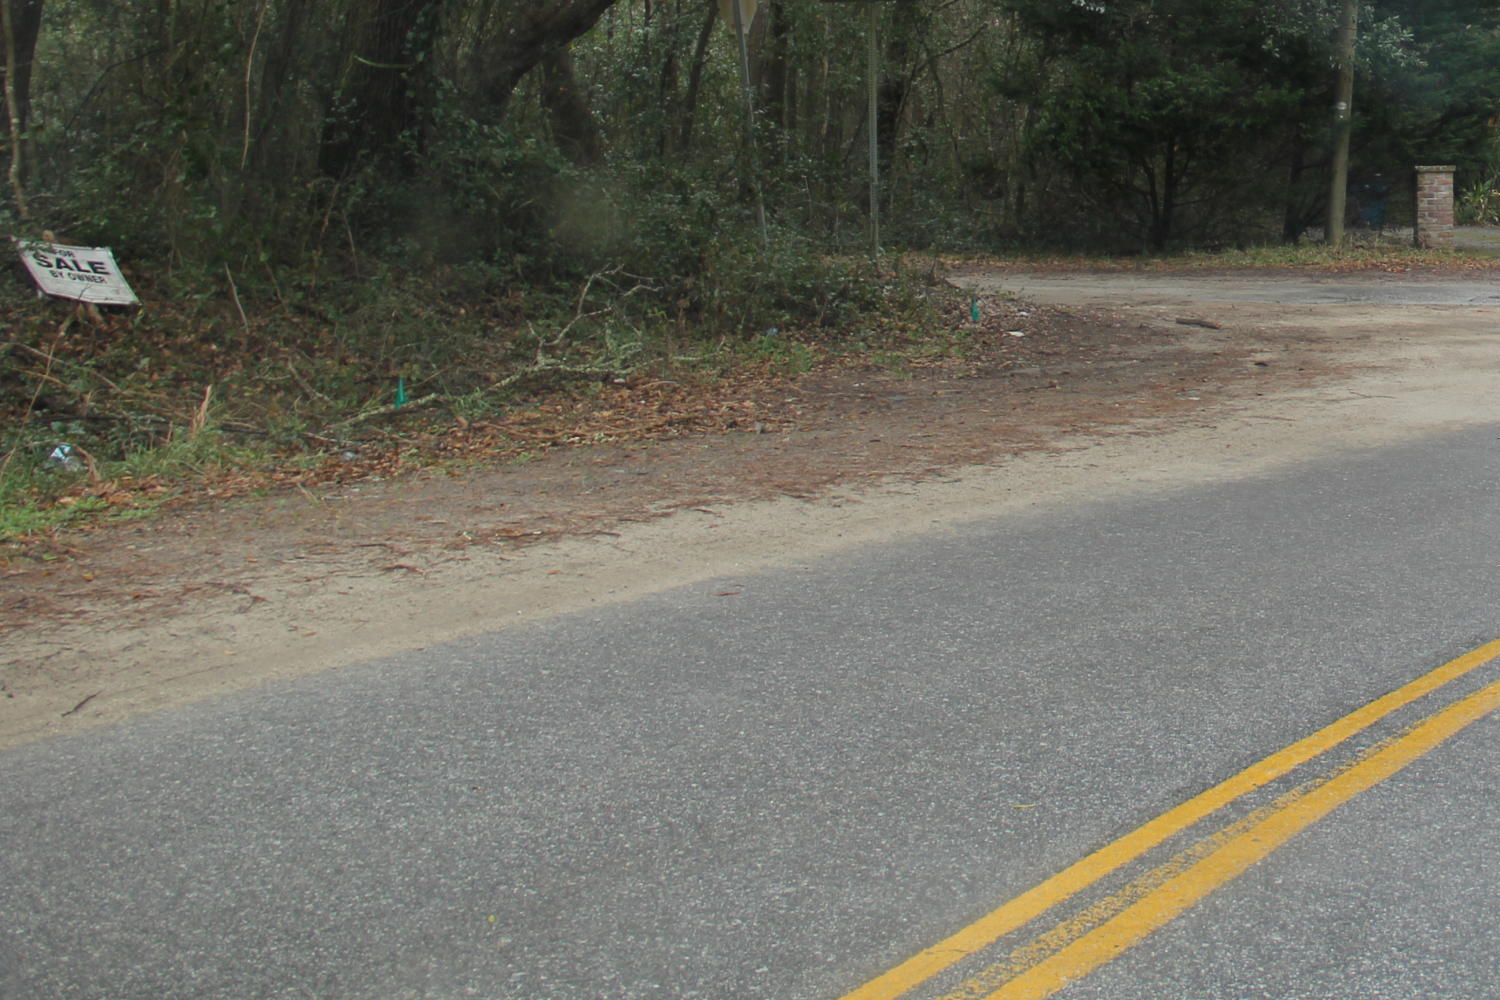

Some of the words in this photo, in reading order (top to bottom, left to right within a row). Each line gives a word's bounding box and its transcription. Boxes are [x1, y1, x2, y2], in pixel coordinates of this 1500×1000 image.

[33, 252, 112, 275] SALE
[49, 270, 64, 279] BY
[67, 272, 108, 284] OWNER
